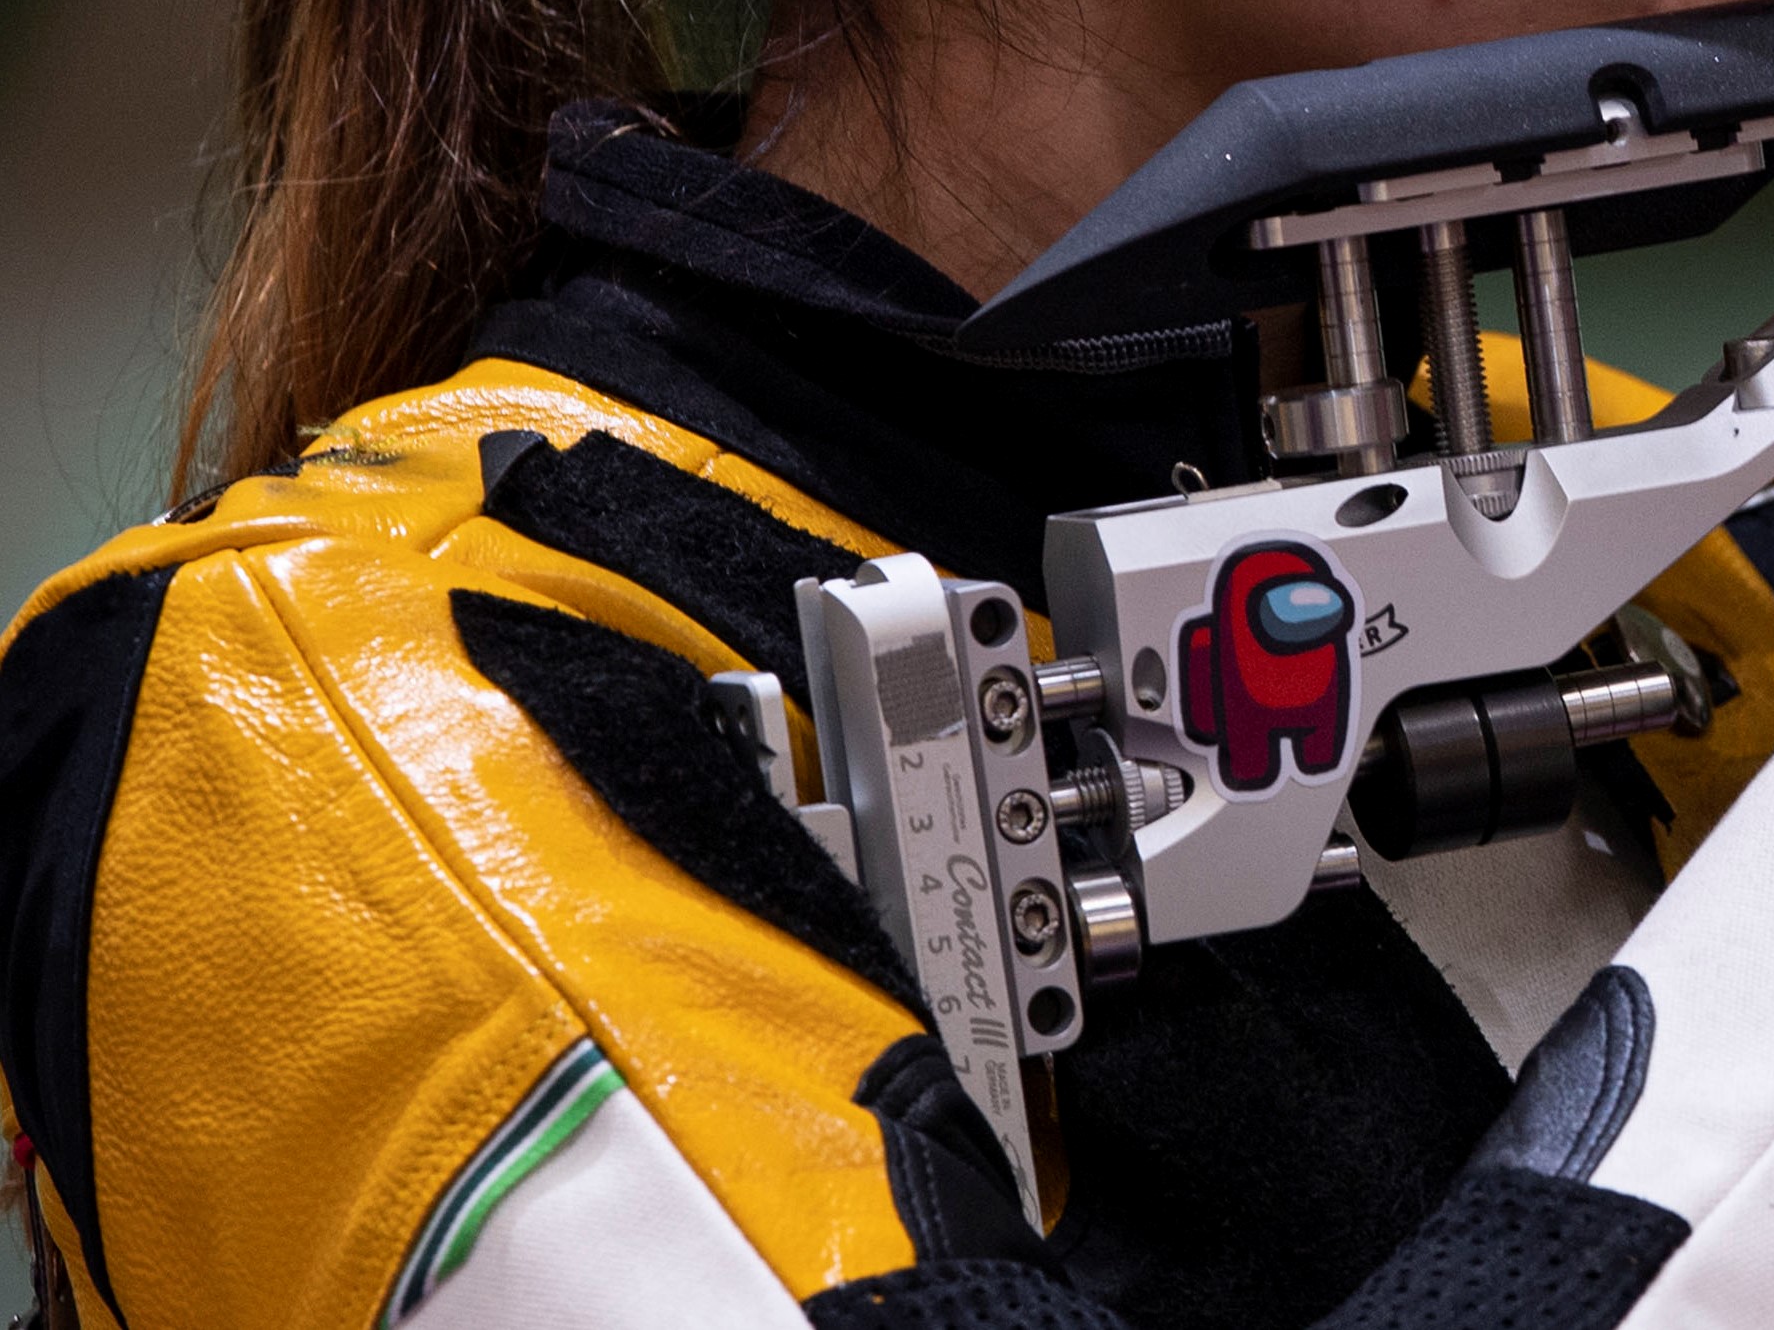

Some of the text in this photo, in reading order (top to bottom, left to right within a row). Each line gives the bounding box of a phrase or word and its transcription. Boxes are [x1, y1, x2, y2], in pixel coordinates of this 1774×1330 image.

[900, 752, 924, 772] 2
[909, 813, 934, 834] 3
[920, 874, 943, 895] 4
[946, 854, 997, 1010] Contact
[928, 935, 952, 954] 5
[937, 995, 962, 1014] 6
